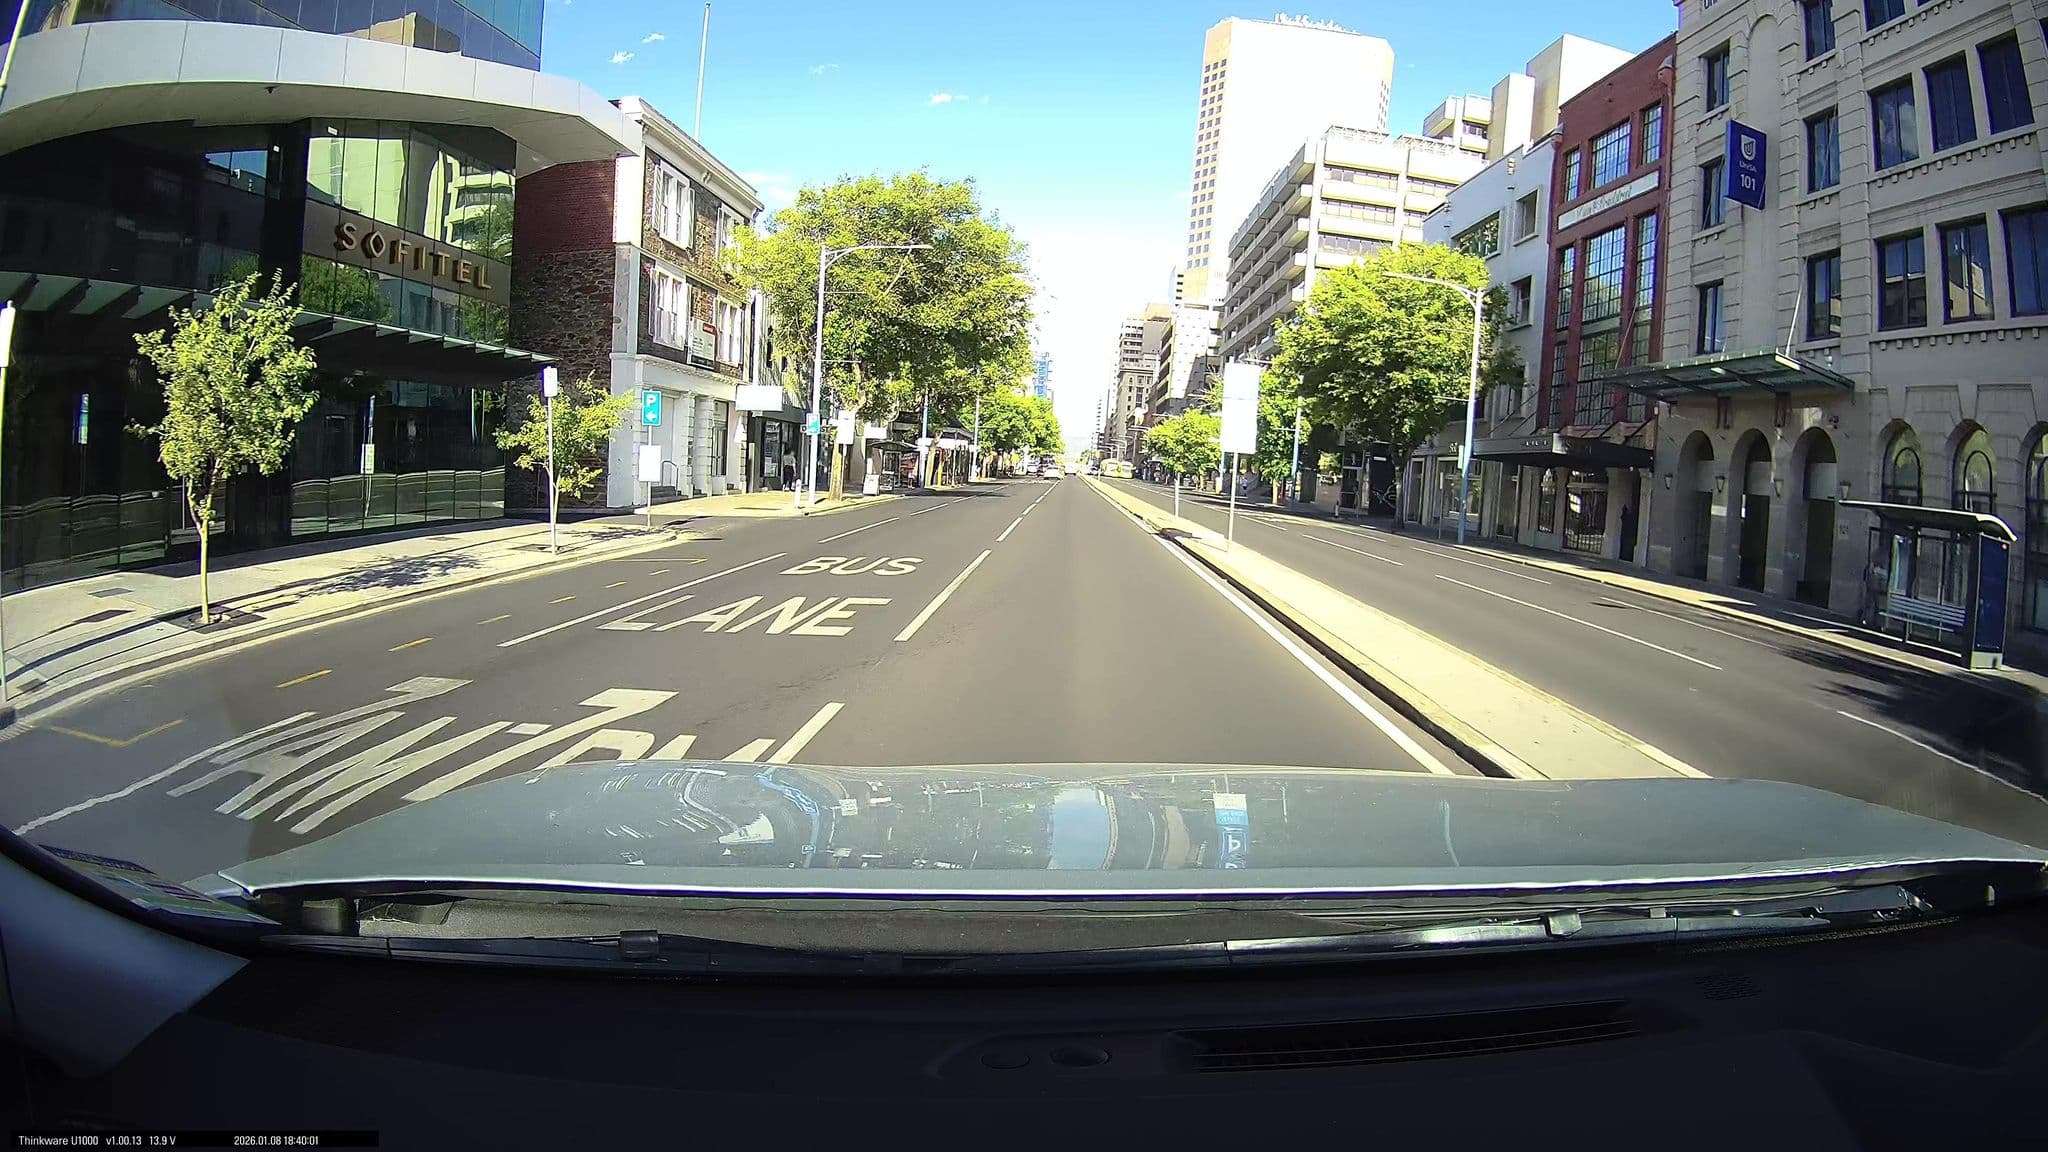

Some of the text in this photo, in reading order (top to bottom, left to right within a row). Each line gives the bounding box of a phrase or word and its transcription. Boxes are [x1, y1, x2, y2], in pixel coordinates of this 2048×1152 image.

[1740, 174, 1755, 191] 101
[335, 222, 492, 289] SOFITEL
[646, 394, 656, 407] P
[778, 556, 923, 575] BUS
[596, 595, 893, 636] LANE
